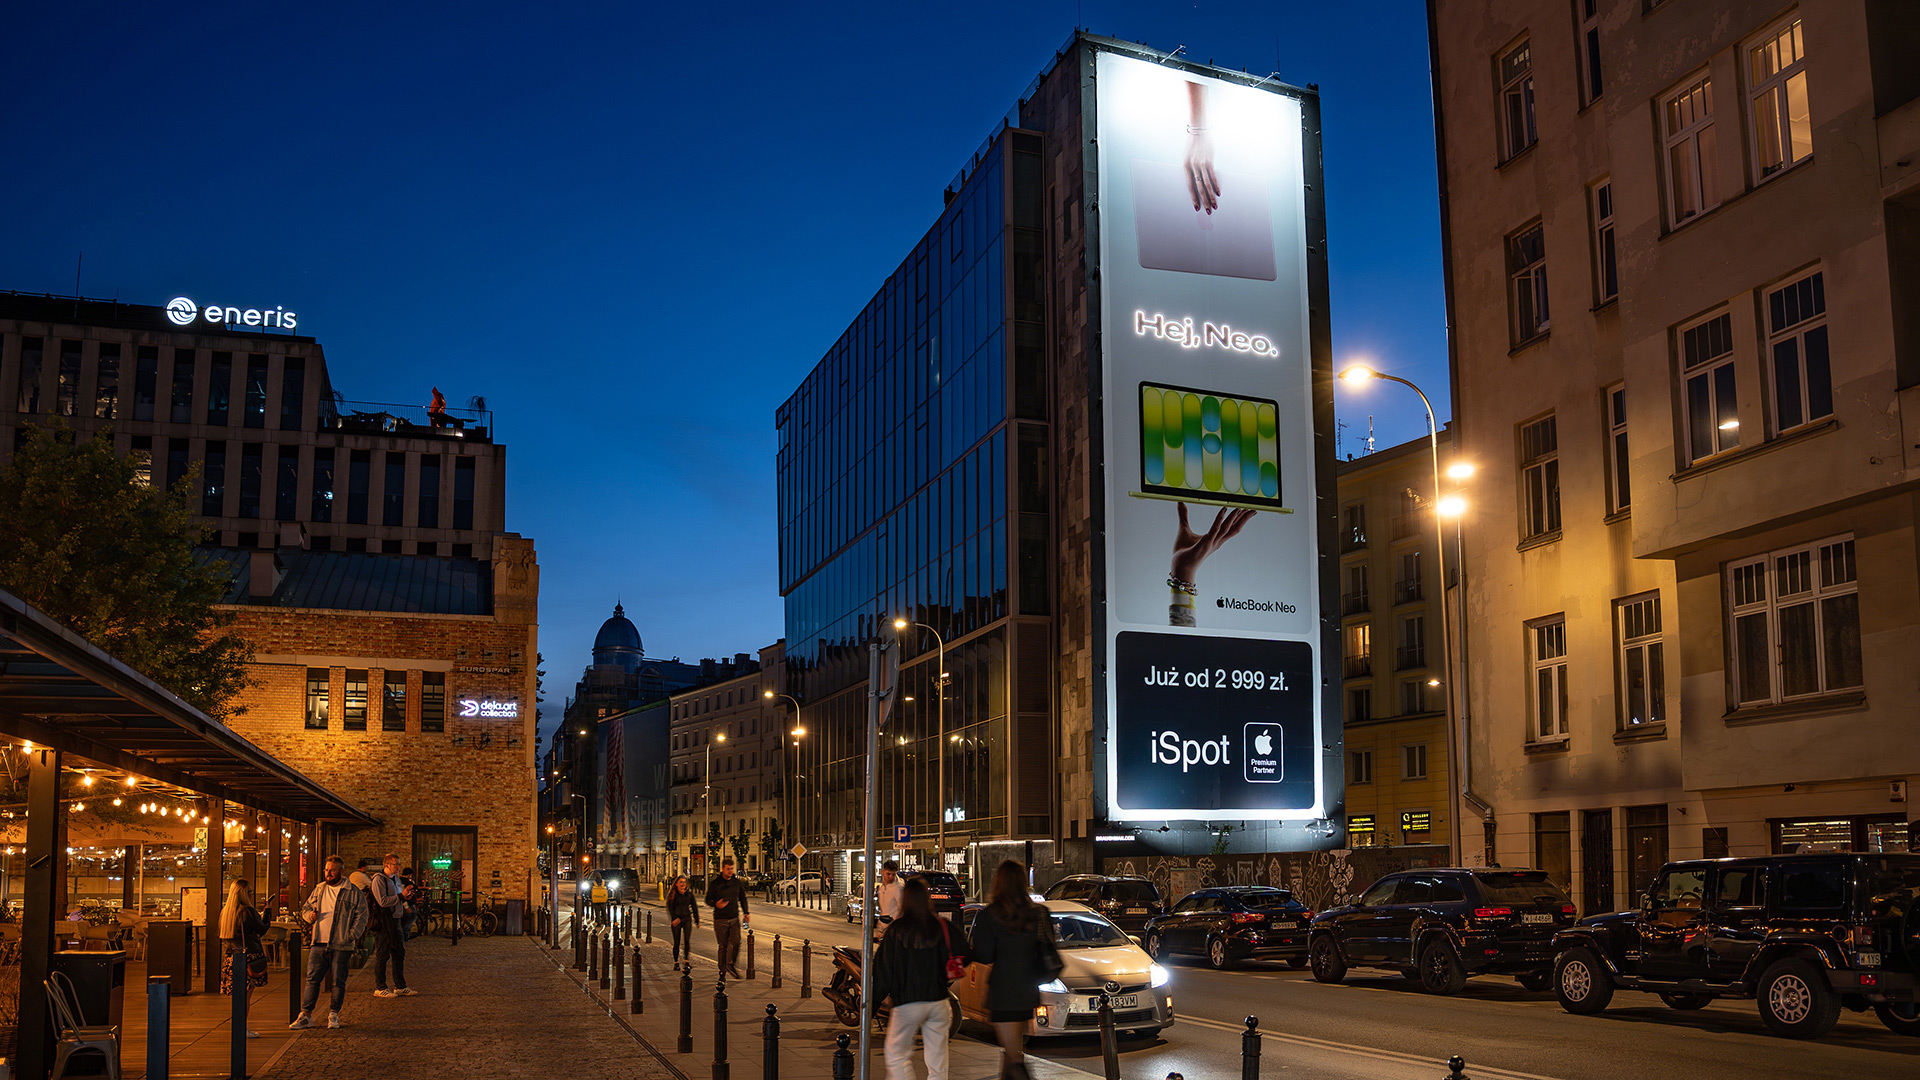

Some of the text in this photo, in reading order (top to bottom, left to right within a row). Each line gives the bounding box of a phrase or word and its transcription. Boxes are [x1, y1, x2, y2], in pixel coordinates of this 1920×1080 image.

[204, 305, 297, 329] eneris
[1135, 310, 1280, 357] Hej, Neo.
[1225, 598, 1296, 614] MacBook Neo
[460, 666, 510, 674] EUROSPAR
[1144, 665, 1289, 691] Już od 2 999 zł.
[480, 709, 517, 717] collection
[1151, 730, 1231, 773] iSpot
[1251, 758, 1277, 767] Premium
[1253, 766, 1275, 775] Partner
[653, 762, 666, 791] W
[630, 797, 666, 827] SIEBIE
[897, 826, 908, 841] P
[428, 838, 463, 855] BAR
[1110, 996, 1136, 1007] 183VM
